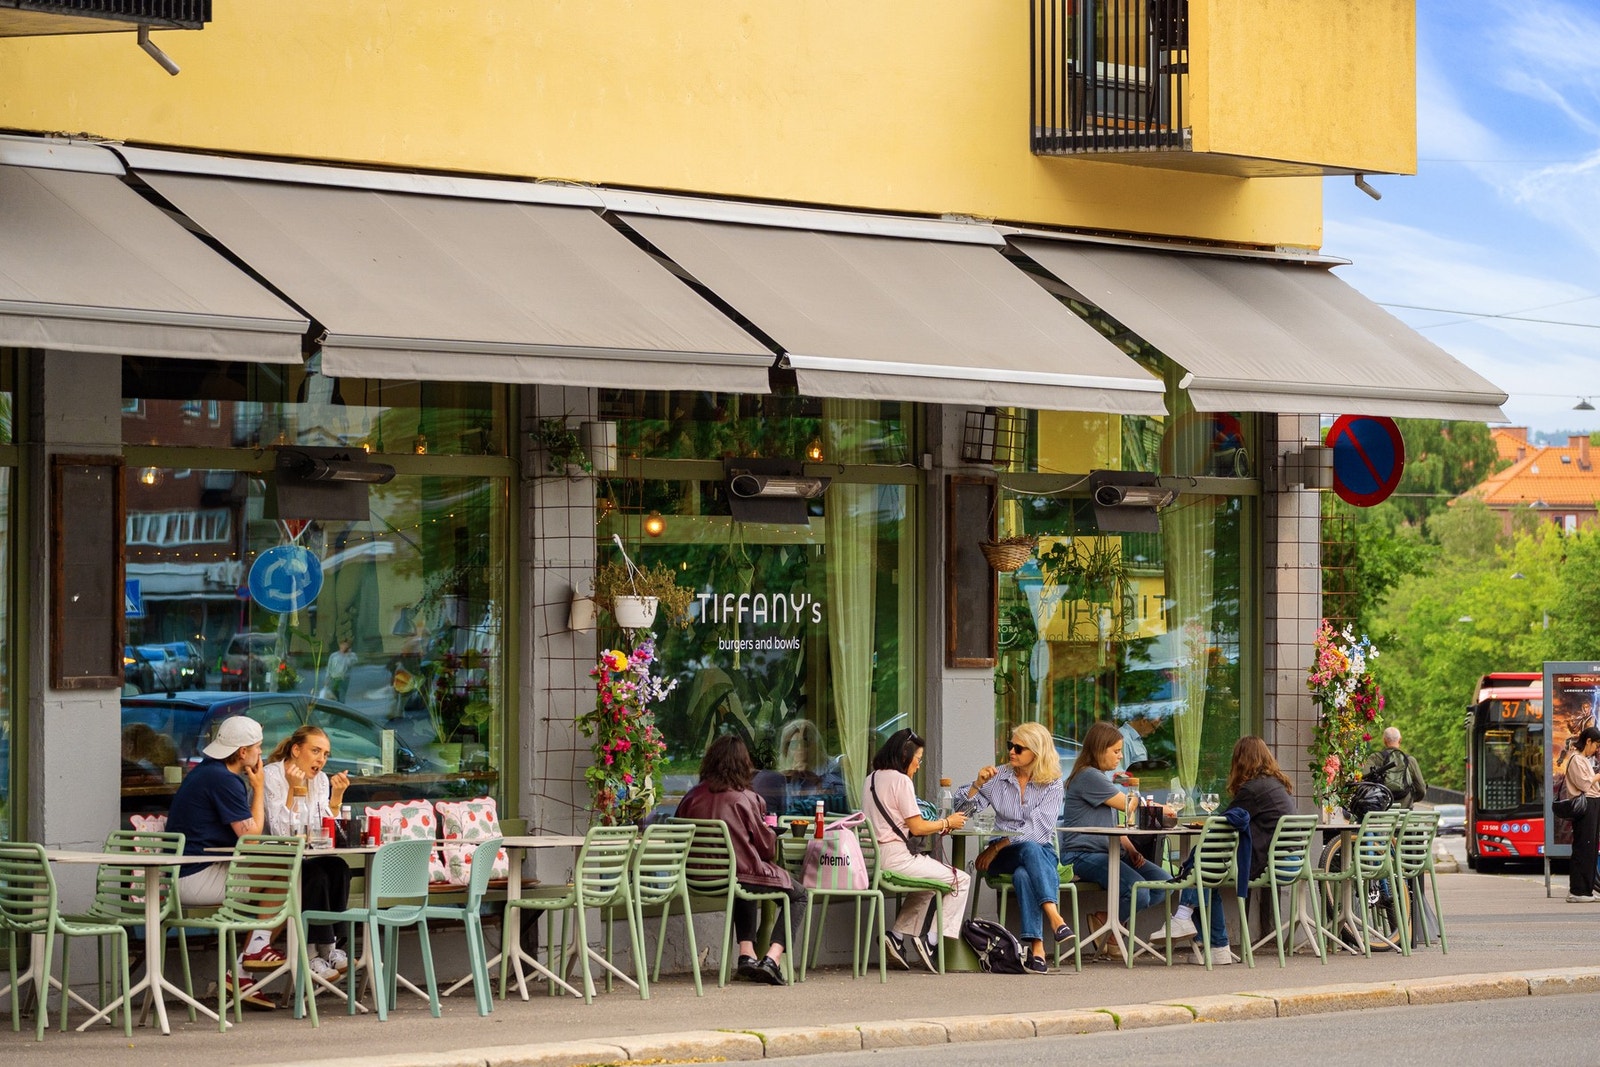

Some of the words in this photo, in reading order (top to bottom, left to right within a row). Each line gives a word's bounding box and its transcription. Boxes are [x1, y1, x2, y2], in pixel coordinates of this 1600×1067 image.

[697, 593, 822, 624] TIFFANY's
[718, 636, 754, 653] burgers
[756, 636, 773, 650] and
[774, 636, 801, 650] bowls
[1501, 701, 1520, 718] 37
[819, 853, 851, 866] chemic
